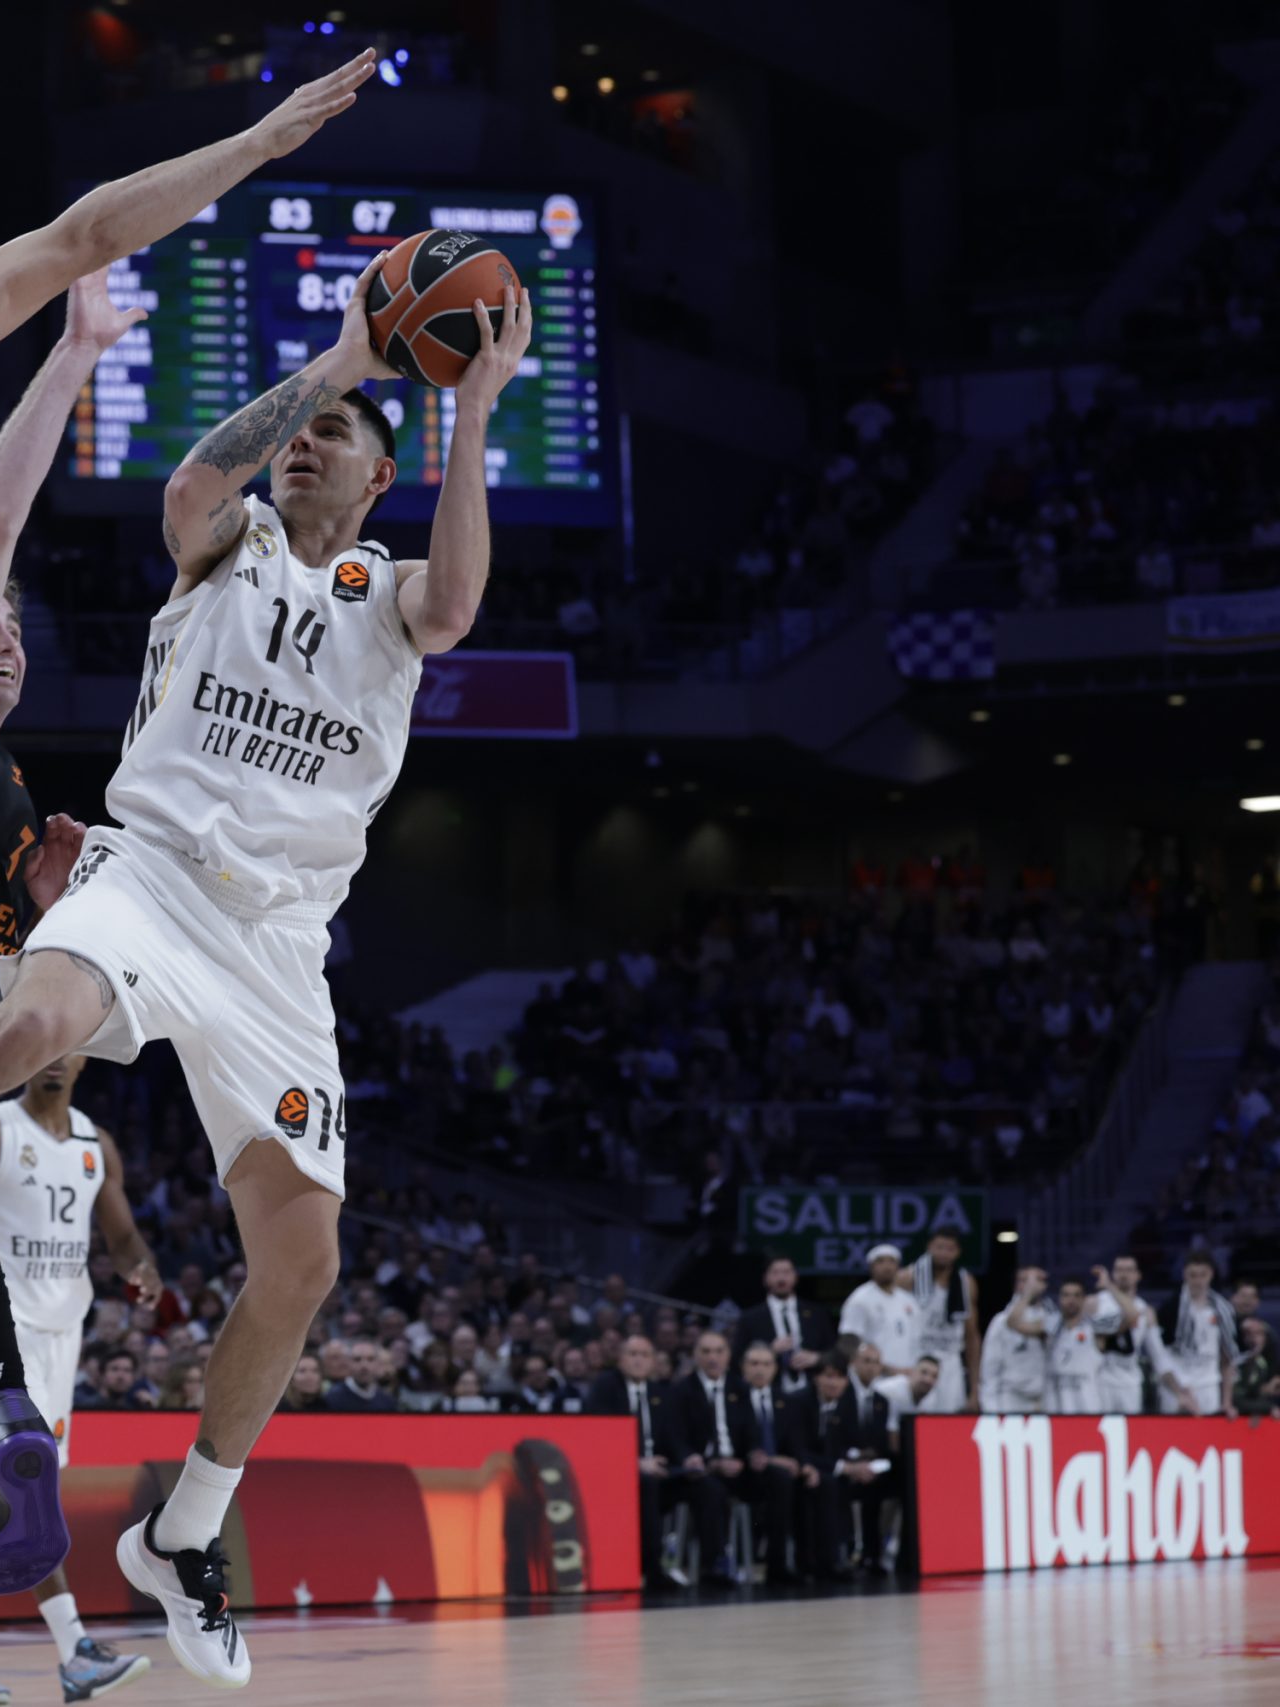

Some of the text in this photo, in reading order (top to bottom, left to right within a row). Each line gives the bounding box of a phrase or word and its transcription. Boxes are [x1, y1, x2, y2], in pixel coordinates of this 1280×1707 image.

[269, 197, 396, 233] 83 67
[265, 597, 326, 675] 14
[193, 671, 362, 755] Emirates
[202, 722, 326, 786] FLY BETTER
[46, 1185, 76, 1223] 12
[753, 1191, 972, 1235] SALIDA
[25, 1260, 47, 1280] FLY
[815, 1237, 913, 1270] EX
[972, 1415, 1249, 1572] Mahou
